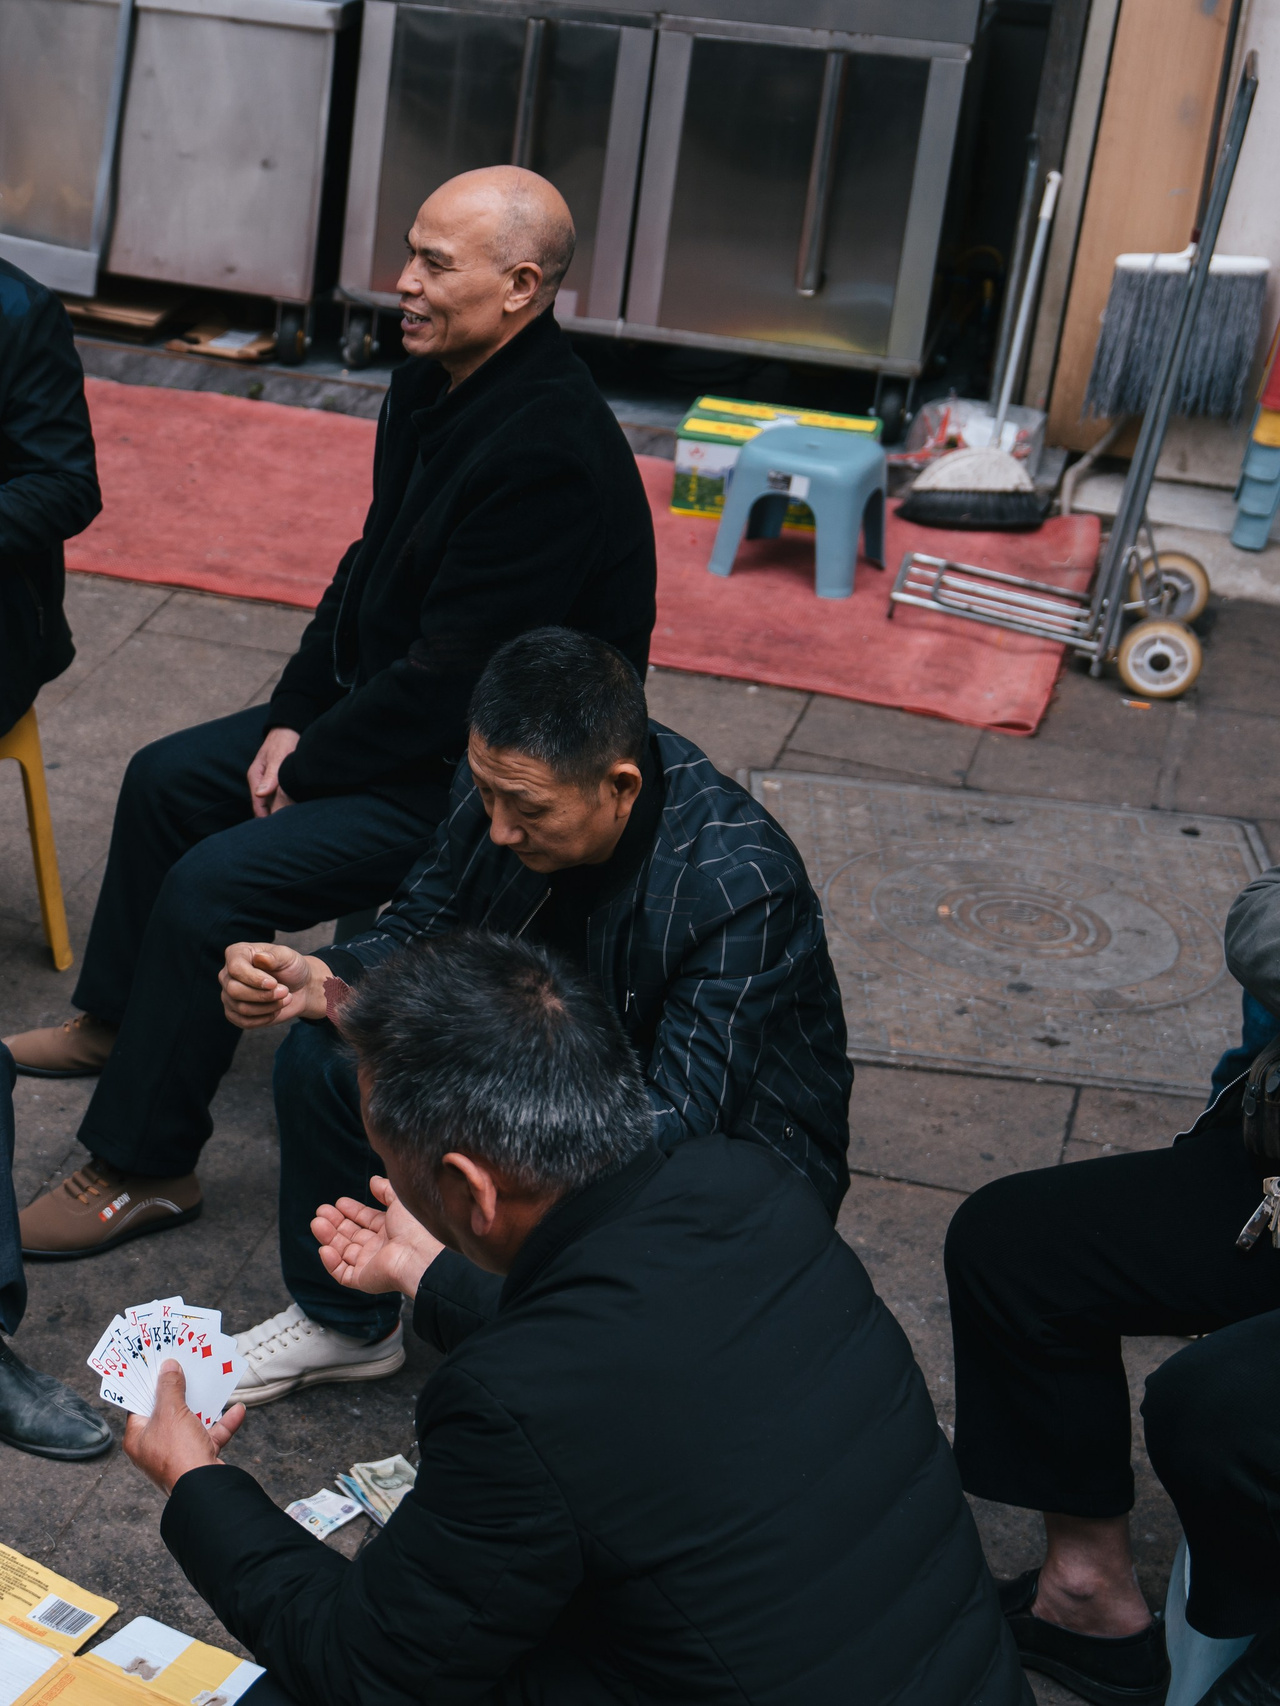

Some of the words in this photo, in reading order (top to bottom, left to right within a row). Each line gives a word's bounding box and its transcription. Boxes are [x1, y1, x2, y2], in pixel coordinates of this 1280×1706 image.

[163, 1306, 171, 1317] K
[131, 1311, 138, 1326] J
[140, 1323, 150, 1338] K
[153, 1327, 161, 1341] K
[163, 1321, 171, 1335] K
[181, 1323, 189, 1336] 7
[124, 1335, 134, 1351] J
[197, 1334, 207, 1345] 4
[111, 1347, 121, 1362] J
[92, 1358, 104, 1370] Q
[105, 1358, 118, 1371] Q
[104, 1389, 116, 1401] 2
